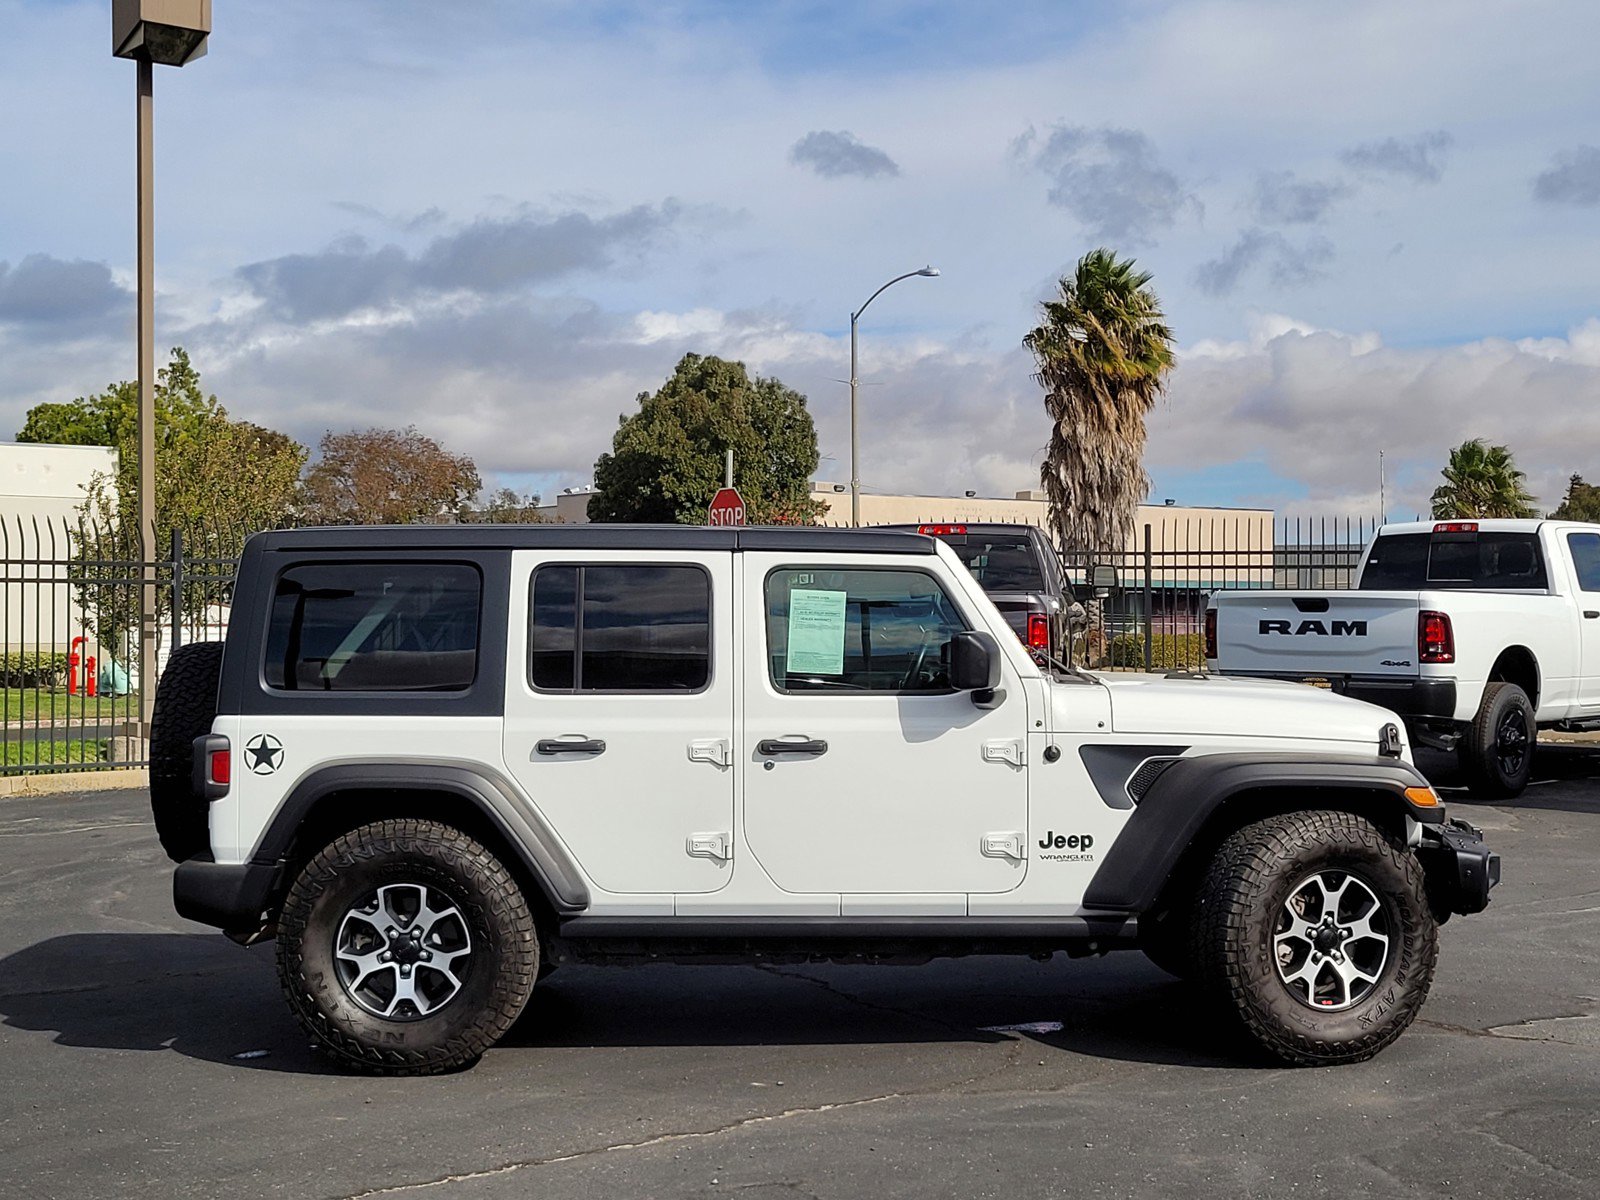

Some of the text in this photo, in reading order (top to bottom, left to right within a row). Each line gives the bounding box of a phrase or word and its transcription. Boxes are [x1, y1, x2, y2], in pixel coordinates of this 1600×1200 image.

[710, 506, 743, 526] STOP
[1258, 619, 1368, 637] RAM
[1038, 830, 1094, 852] Jeep
